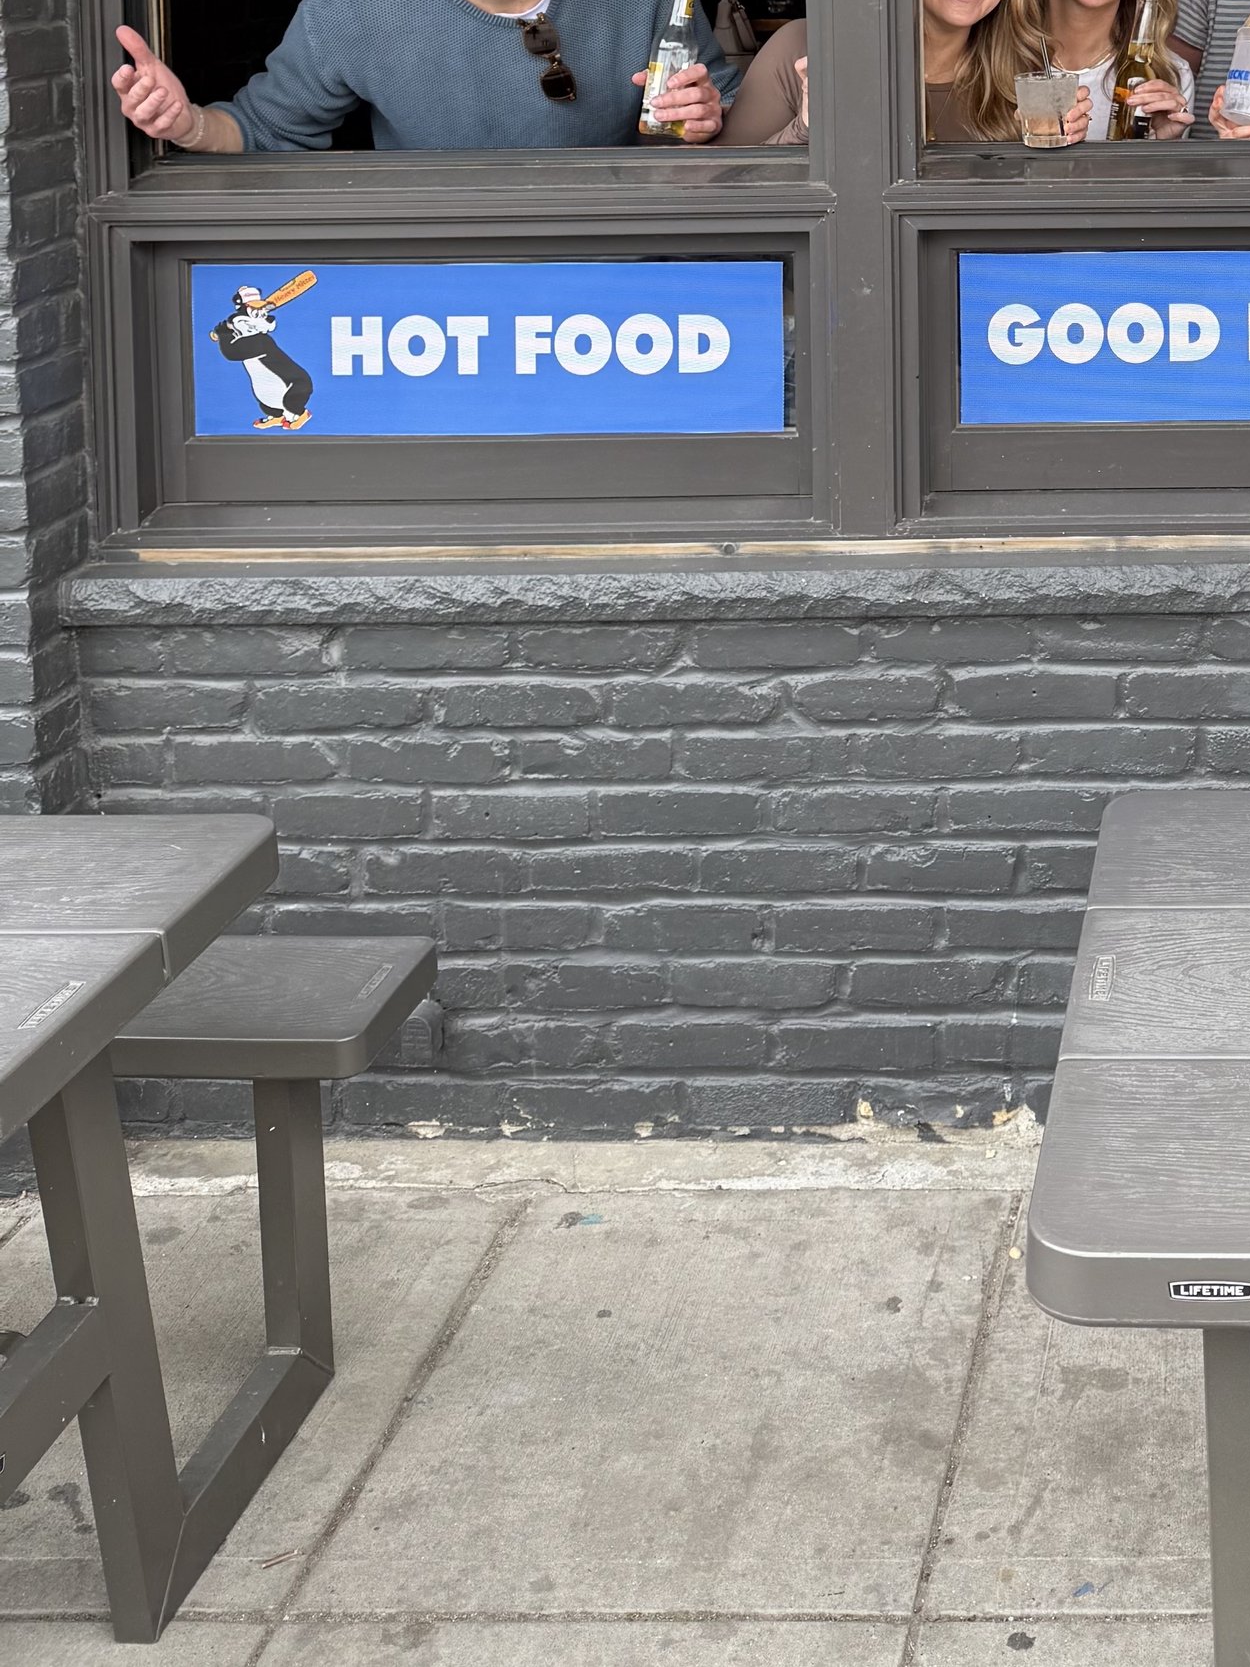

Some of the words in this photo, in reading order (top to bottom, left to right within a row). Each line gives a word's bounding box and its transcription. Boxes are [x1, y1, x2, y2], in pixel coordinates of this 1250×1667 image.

[331, 314, 490, 376] HOT
[515, 313, 731, 376] FOOD
[987, 302, 1222, 365] GOOD
[1180, 1285, 1244, 1296] LIFETIME
